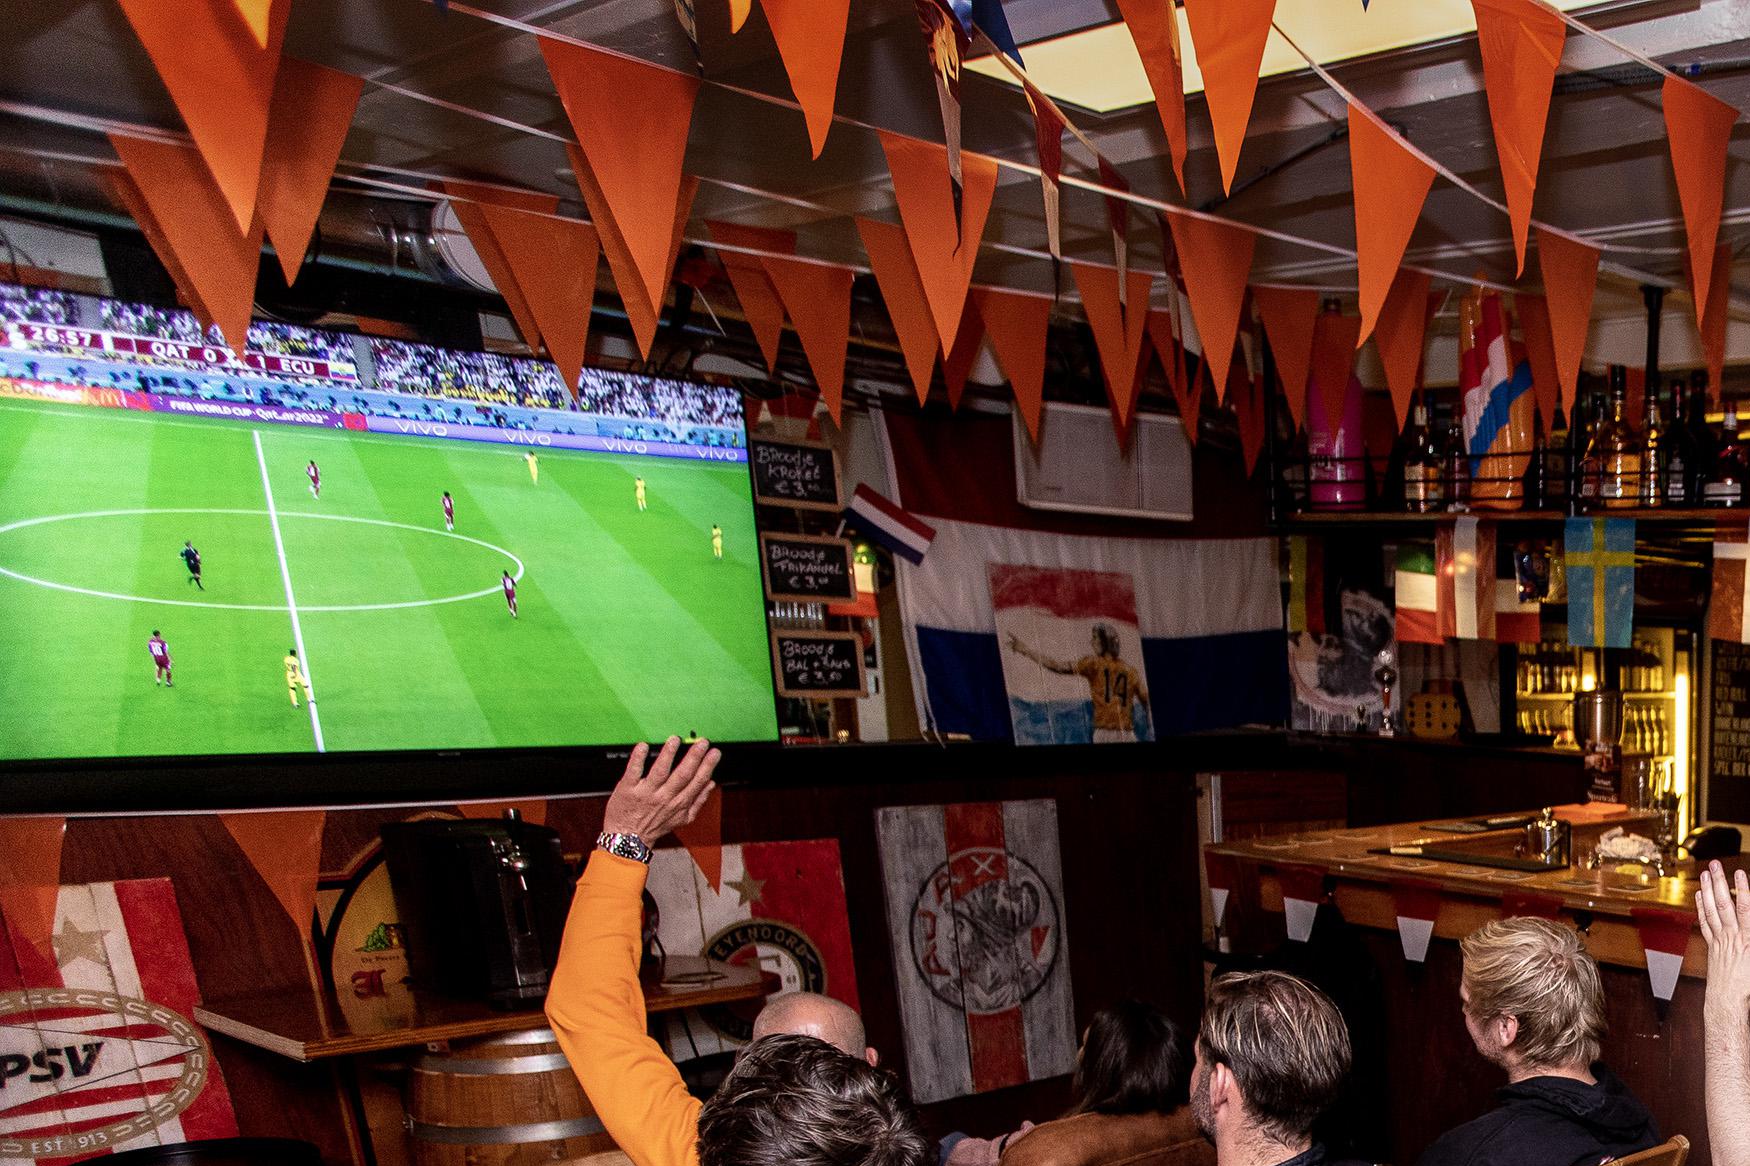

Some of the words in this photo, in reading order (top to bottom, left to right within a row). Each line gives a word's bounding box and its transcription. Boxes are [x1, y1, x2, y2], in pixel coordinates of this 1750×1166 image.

[31, 326, 92, 345] 26:57
[151, 341, 190, 360] QAT
[204, 350, 217, 363] 0
[259, 356, 266, 369] 1
[280, 358, 315, 375] ECU
[396, 418, 448, 437] vivo
[504, 430, 552, 446] vivo
[603, 438, 648, 454] vivo
[696, 446, 738, 461] vivo
[1104, 667, 1128, 708] 14
[0, 1041, 104, 1089] PSV
